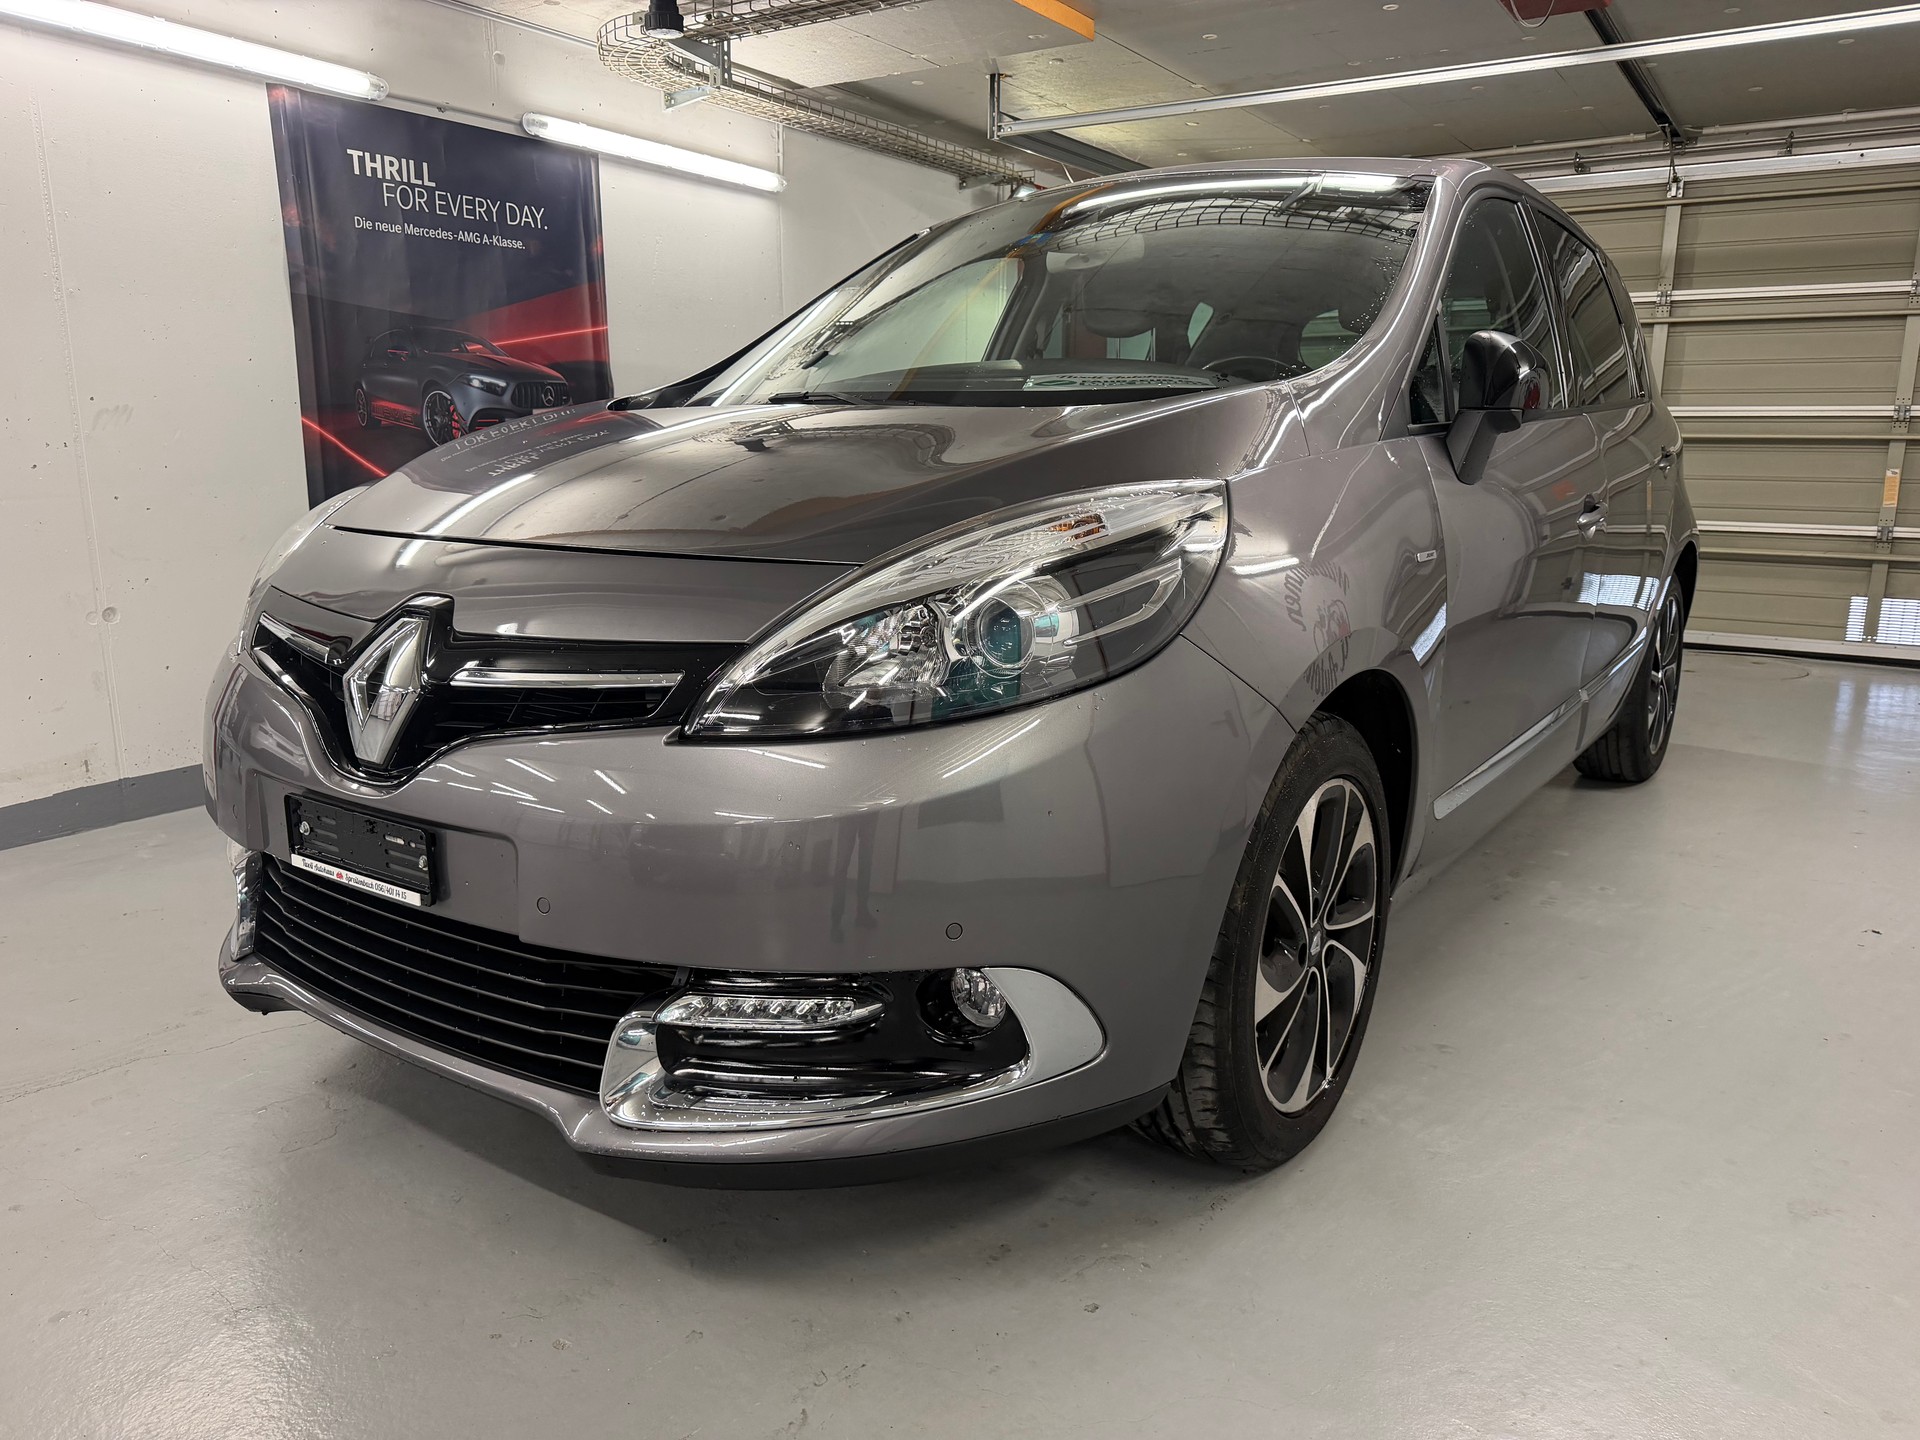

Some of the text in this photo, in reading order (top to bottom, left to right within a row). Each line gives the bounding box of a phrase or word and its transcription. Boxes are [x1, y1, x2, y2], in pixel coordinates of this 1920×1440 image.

[346, 148, 436, 187] THRILL
[382, 182, 548, 230] FOR EVERY DAY.
[354, 216, 526, 249] Die neue Mercedes-AMG A-Klasse.
